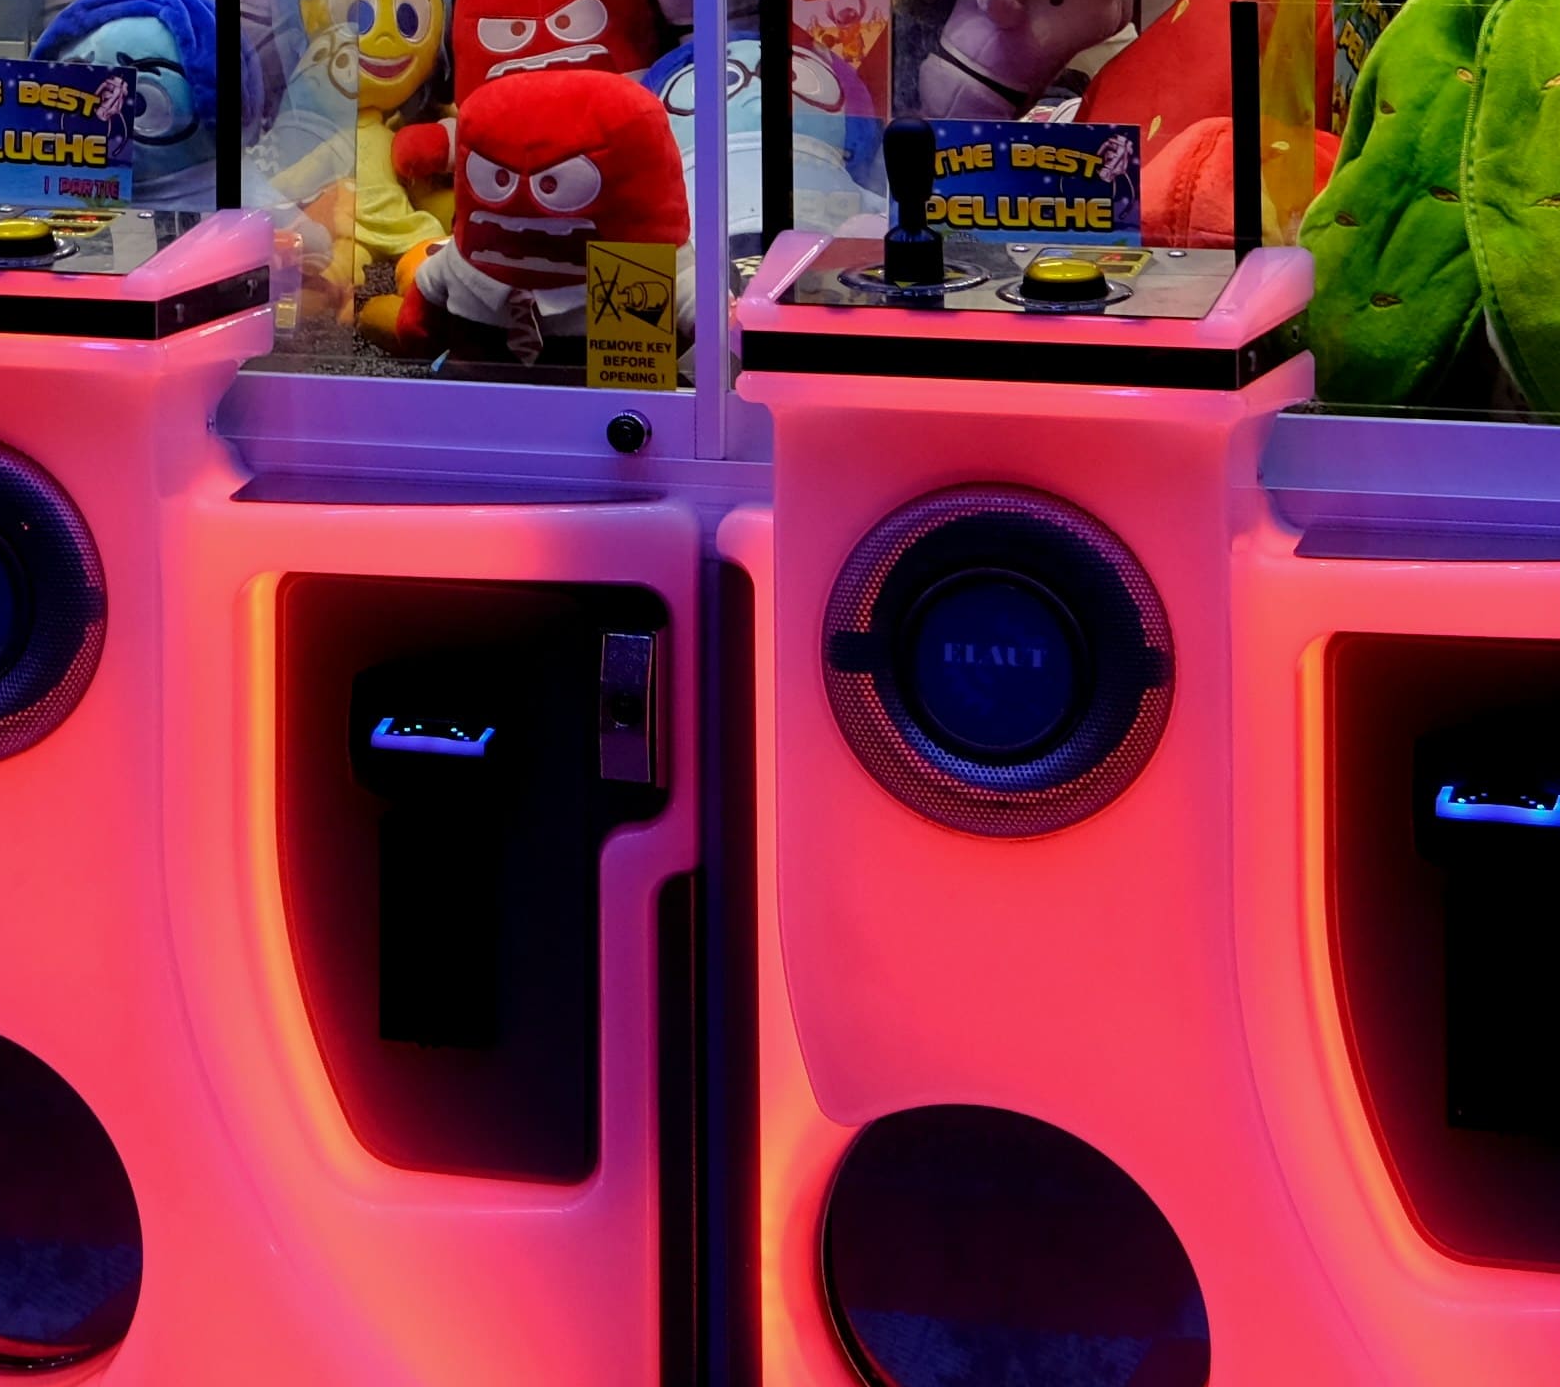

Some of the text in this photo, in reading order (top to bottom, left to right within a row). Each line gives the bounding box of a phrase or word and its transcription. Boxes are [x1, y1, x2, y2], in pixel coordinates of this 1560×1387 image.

[18, 80, 101, 117] BEST
[935, 143, 1103, 178] THE BEST
[59, 176, 120, 200] PARTIE
[926, 196, 1112, 229] PELUCHE
[589, 339, 672, 354] REMOVE KEY
[603, 355, 656, 368] BEFORE
[600, 370, 658, 385] OPENING
